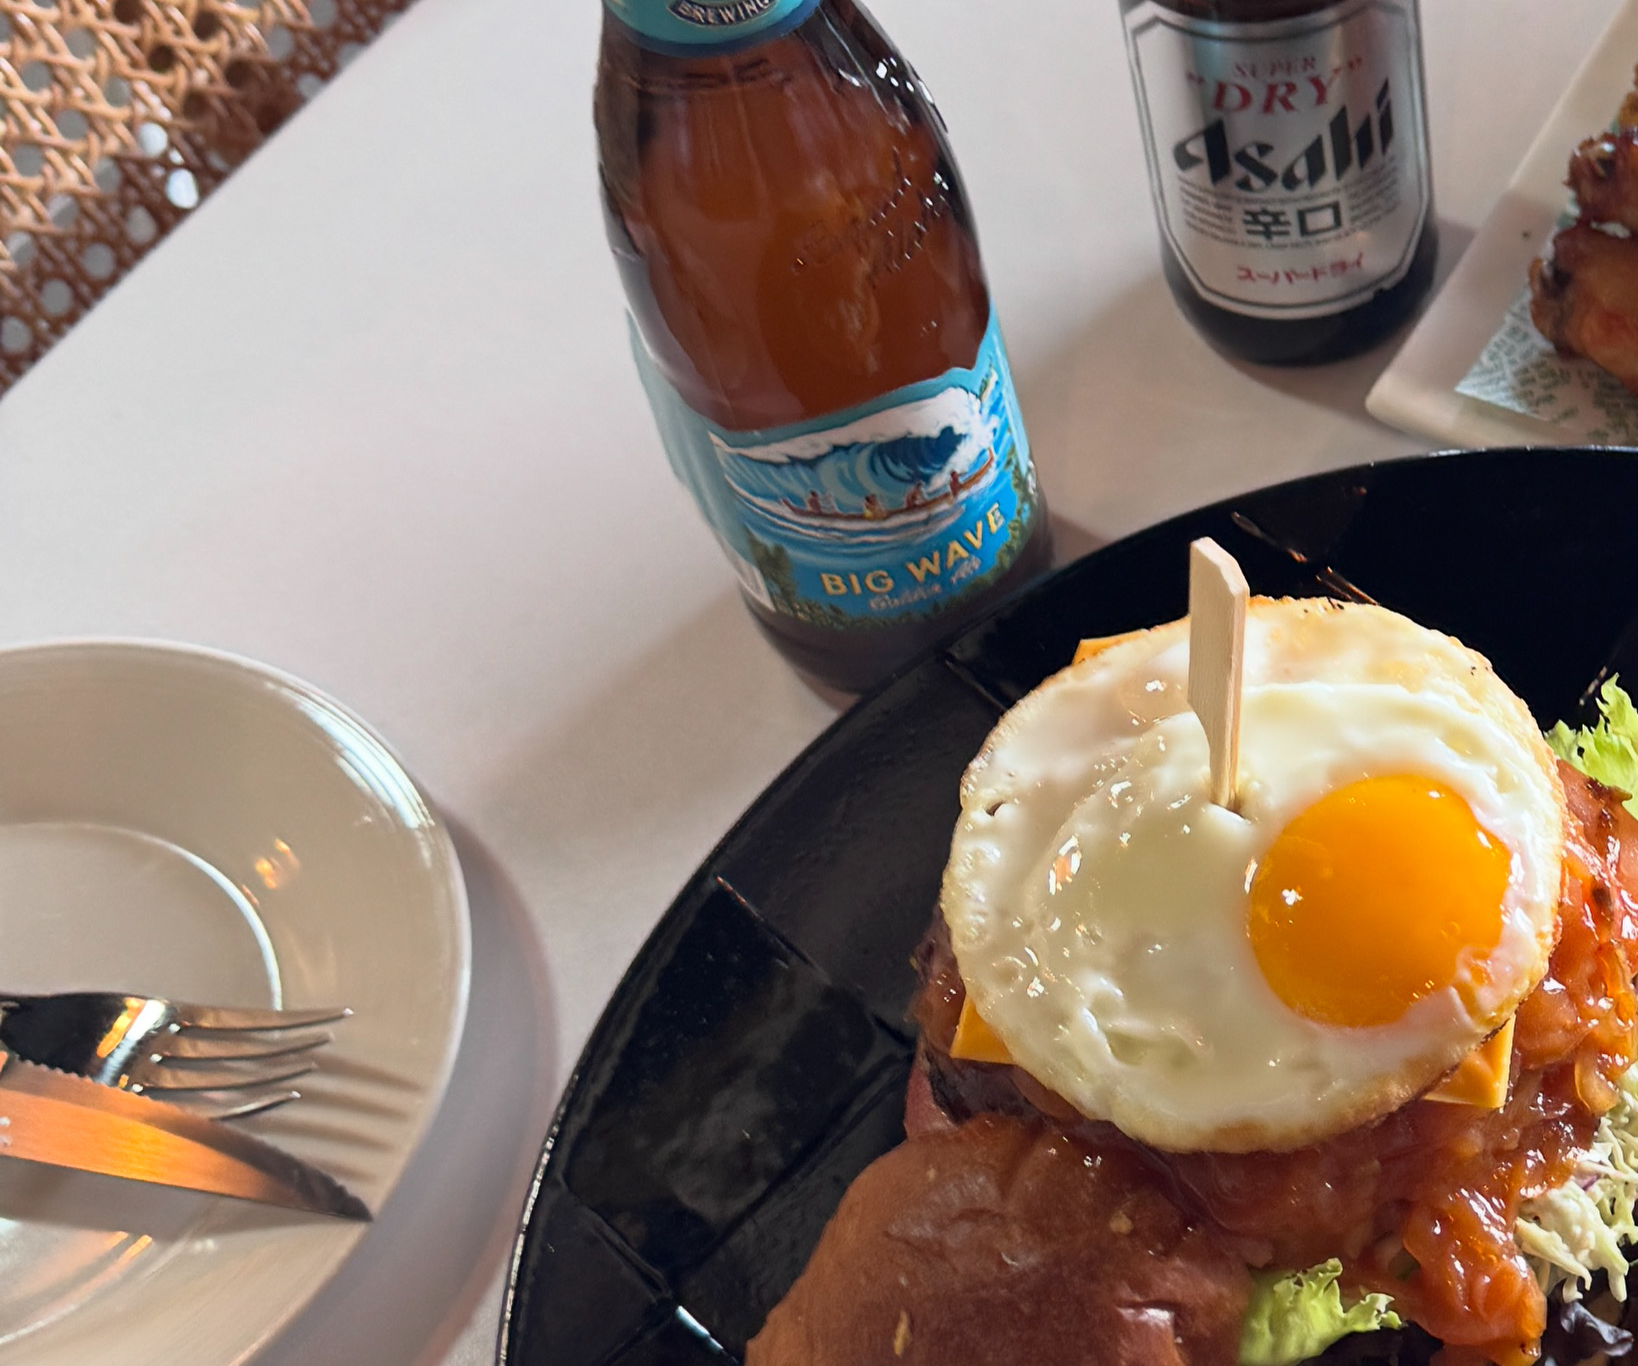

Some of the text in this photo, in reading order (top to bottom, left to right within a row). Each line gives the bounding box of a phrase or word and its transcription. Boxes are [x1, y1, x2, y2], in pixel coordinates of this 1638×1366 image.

[1236, 56, 1316, 79] SUPER
[1173, 77, 1394, 191] Asahi
[1242, 200, 1342, 240] 辛口
[1237, 253, 1363, 284] スーパードライ
[820, 569, 895, 597] BIG
[905, 501, 1005, 584] WAVE
